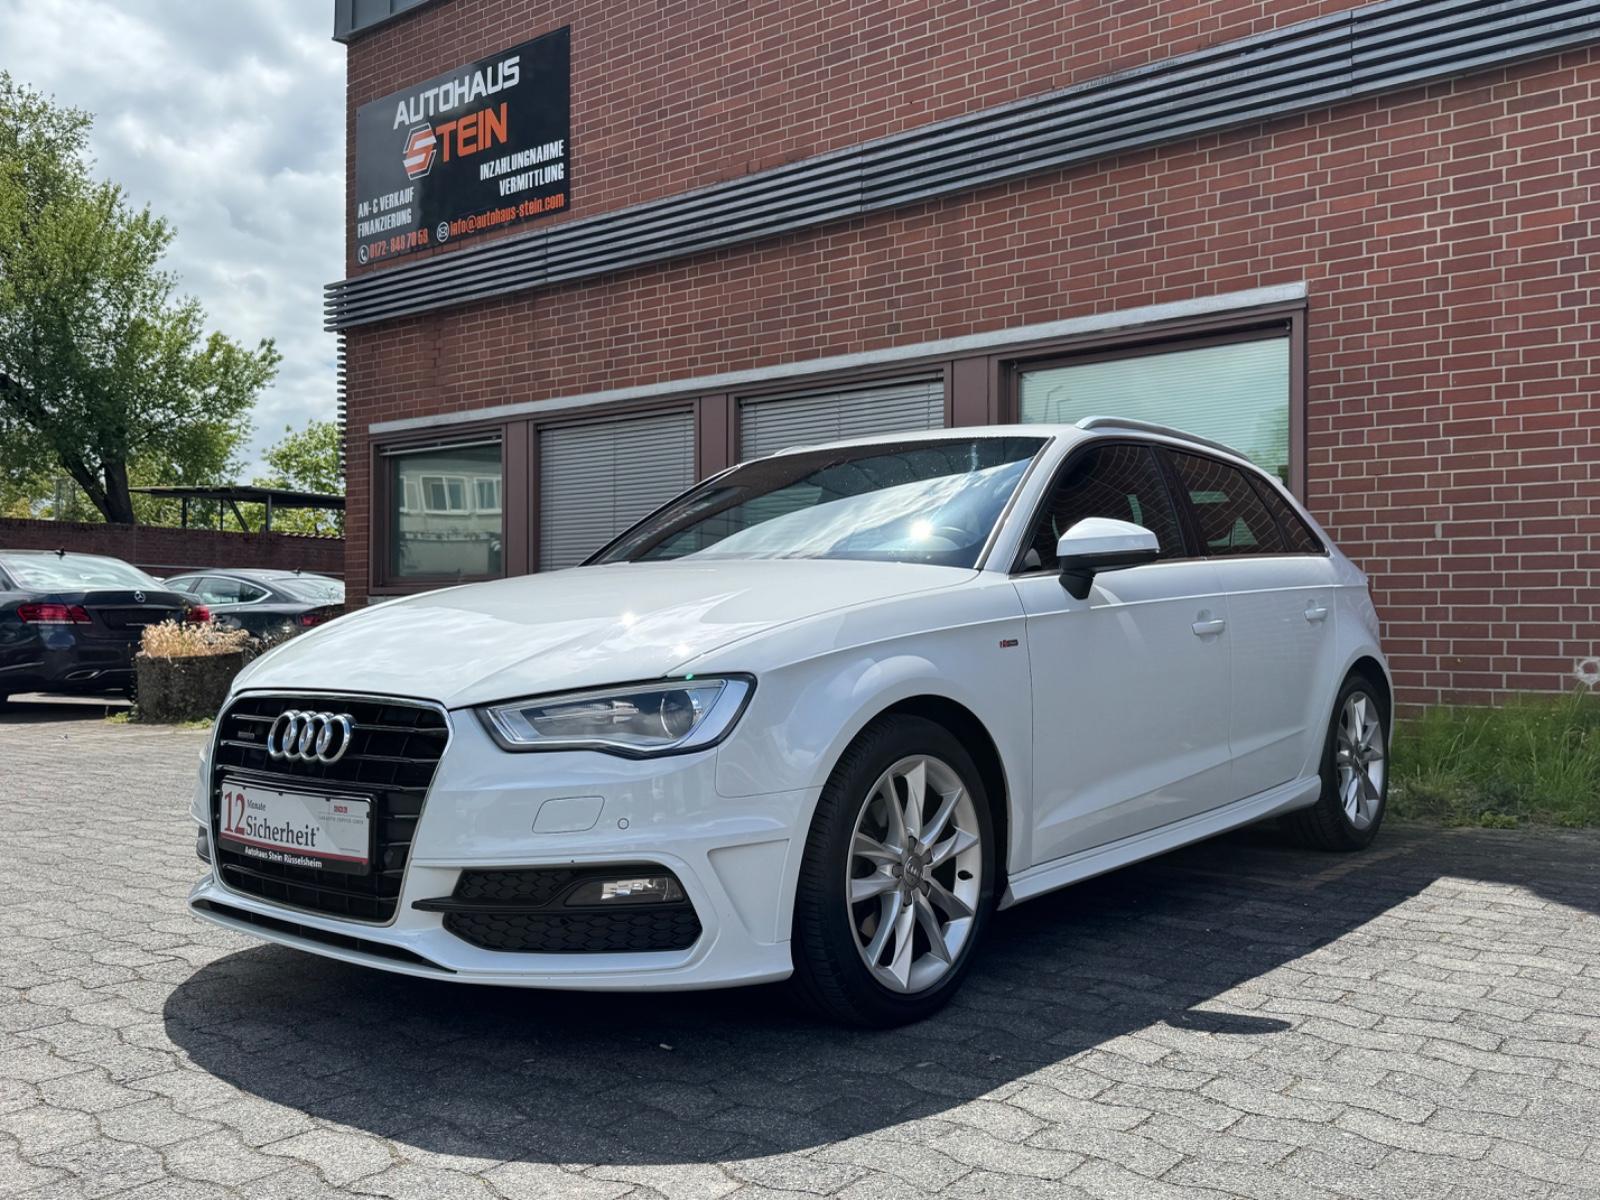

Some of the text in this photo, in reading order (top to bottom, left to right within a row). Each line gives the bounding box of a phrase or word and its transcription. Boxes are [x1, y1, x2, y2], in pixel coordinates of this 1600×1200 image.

[393, 56, 520, 130] AUTOHAUS
[403, 102, 508, 180] STEIN
[480, 139, 565, 181] INZAHLUNGNAHME
[500, 162, 565, 197] VERMITTLUNG
[358, 201, 372, 219] AN-
[379, 186, 415, 212] VERKAUF
[358, 207, 412, 239] FINANZIERUNG
[450, 193, 565, 237] info@autohaus-stein.com
[224, 791, 246, 836] 12
[244, 846, 323, 868] Autohaus Stein Rüsselsheim
